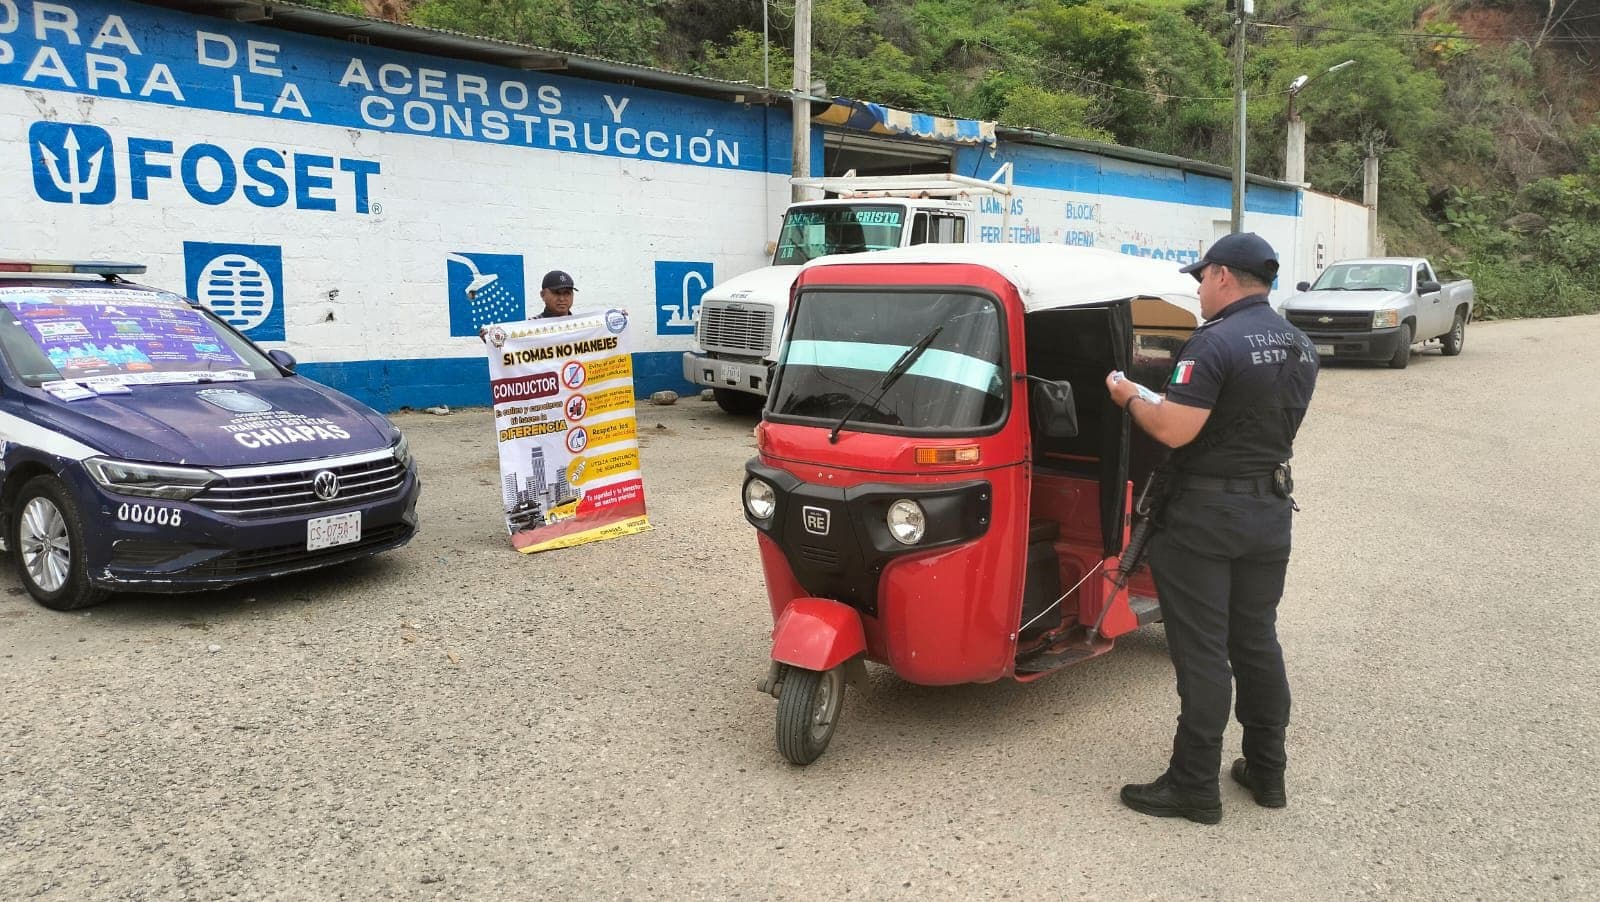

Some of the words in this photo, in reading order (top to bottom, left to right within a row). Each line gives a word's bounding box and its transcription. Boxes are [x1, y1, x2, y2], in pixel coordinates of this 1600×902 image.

[196, 30, 284, 78] DE
[338, 57, 562, 116] ACEROS
[602, 94, 631, 124] Y
[233, 75, 312, 118] LA
[360, 94, 740, 167] CONSTRUCCIÓN
[127, 136, 381, 215] FOSET
[980, 196, 1024, 216] LAMAS
[1066, 203, 1095, 220] BLOCK
[856, 211, 900, 224] CRISTO
[980, 226, 1041, 244] FERETERIA
[1243, 329, 1309, 348] TRÁNSO
[503, 352, 514, 366] SI
[515, 346, 554, 364] TOMAS
[556, 344, 572, 359] NO
[573, 337, 618, 355] MANEJES
[1250, 348, 1315, 366] ESTAAL
[493, 376, 558, 399] CONDUCTOR
[279, 417, 334, 426] ESTATAL
[499, 419, 568, 443] DIFERENCIA
[234, 424, 351, 449] CHIAPAS
[117, 502, 182, 527] 00008
[807, 515, 825, 530] RE
